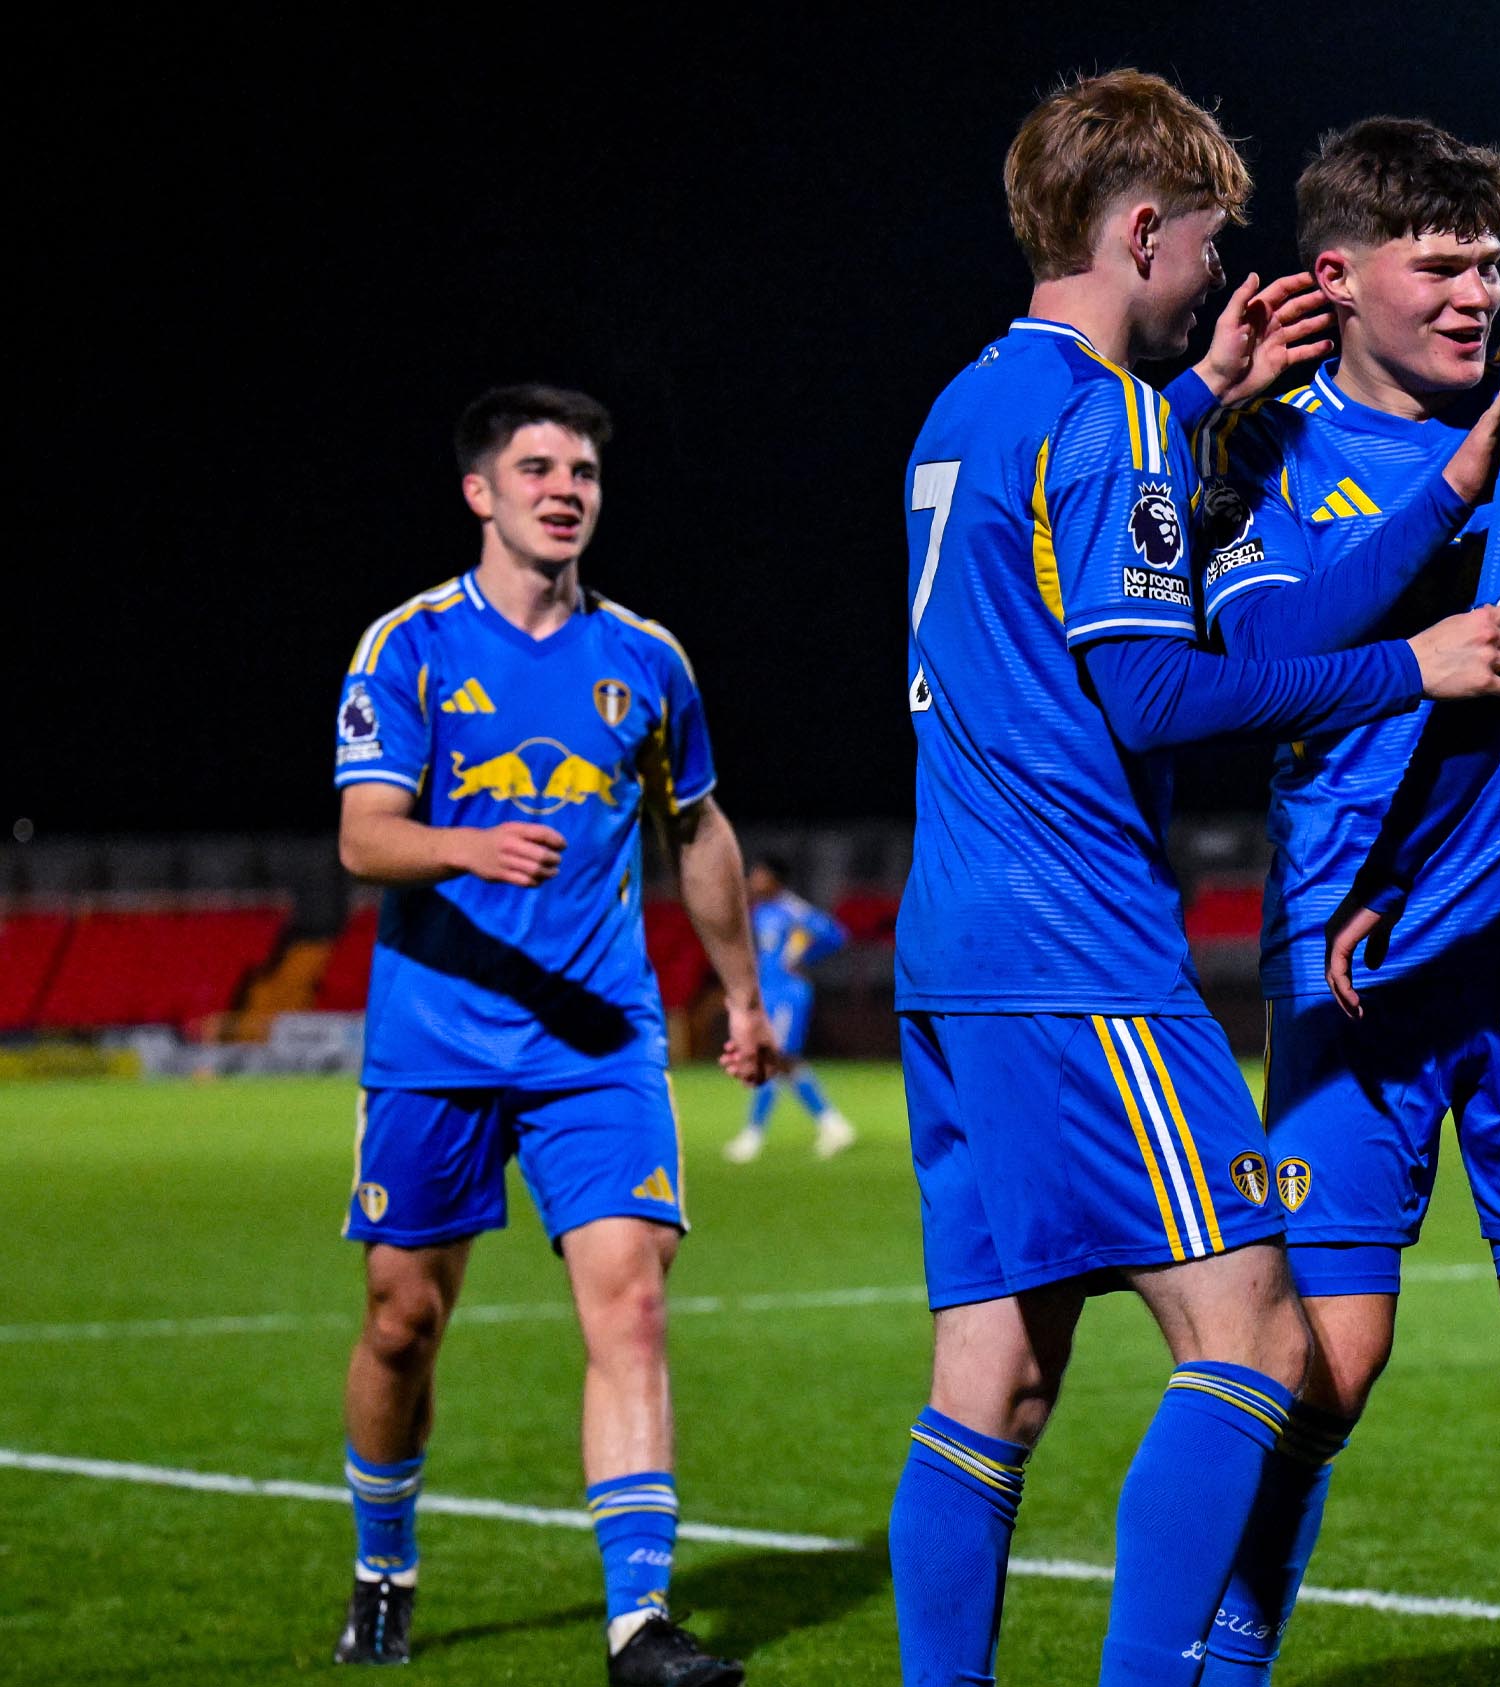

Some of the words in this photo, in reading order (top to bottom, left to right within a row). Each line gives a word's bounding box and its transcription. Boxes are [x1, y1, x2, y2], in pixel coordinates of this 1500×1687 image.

[911, 459, 961, 640] 7
[1207, 561, 1218, 575] No
[1216, 543, 1255, 566] room
[1220, 551, 1264, 577] racism
[1124, 568, 1147, 584] No
[1150, 573, 1184, 593] room
[1124, 582, 1146, 598] for
[1149, 587, 1191, 607] racism
